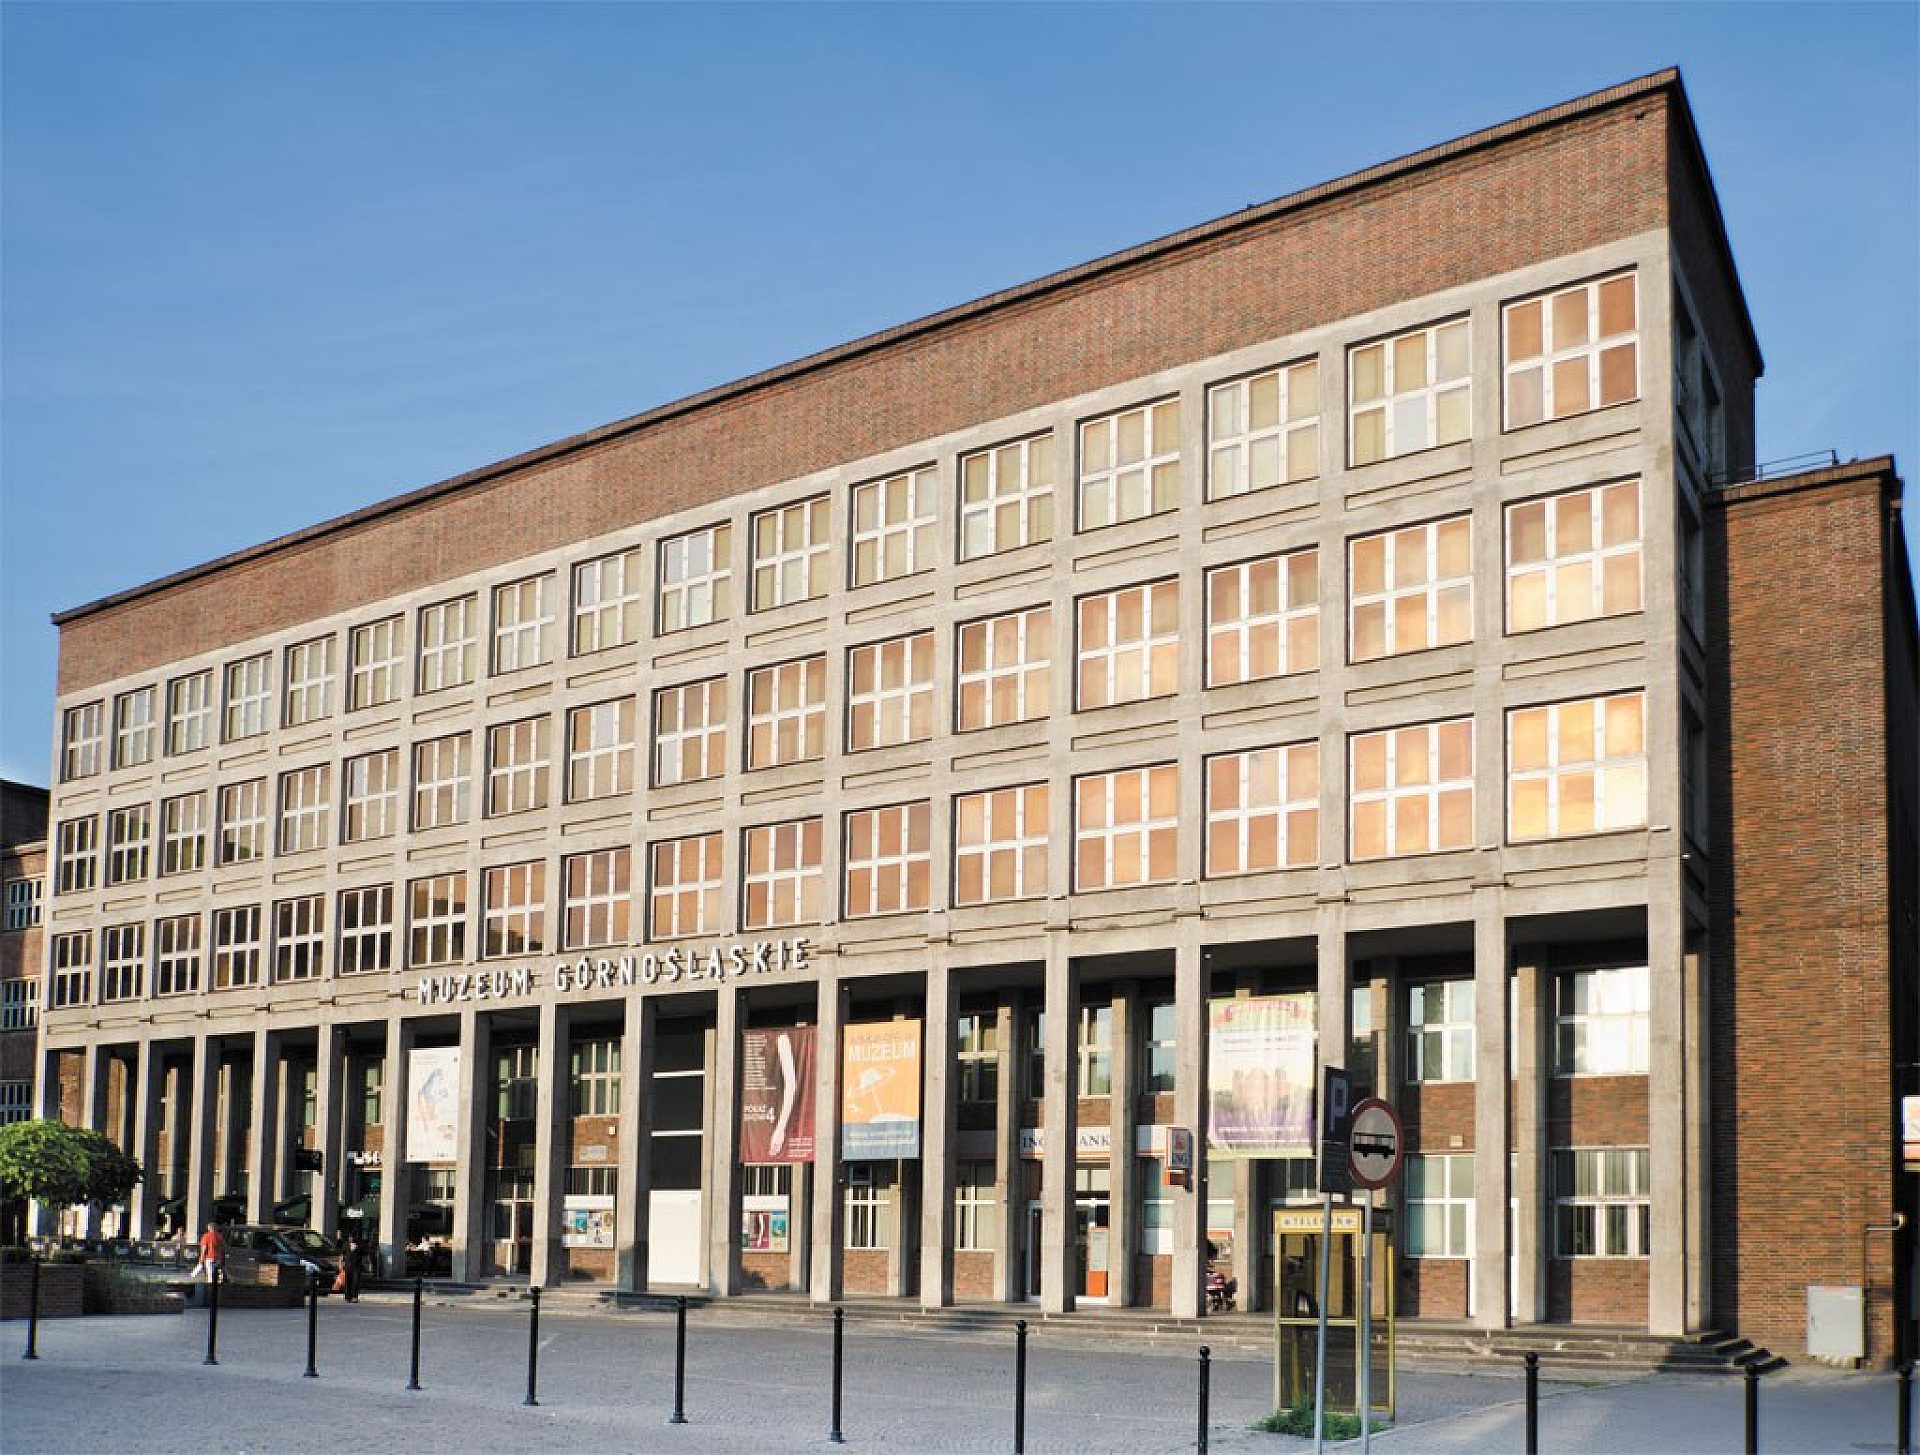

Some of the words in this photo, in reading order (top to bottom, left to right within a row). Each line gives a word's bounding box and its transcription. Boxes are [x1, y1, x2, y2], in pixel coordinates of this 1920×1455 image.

[418, 968, 532, 1004] MUZEUM
[555, 937, 810, 991] GÓRNOŚLĄSKIE
[848, 1039, 916, 1063] MUZEUM
[1330, 1076, 1348, 1133] P
[1079, 1135, 1110, 1147] ANK
